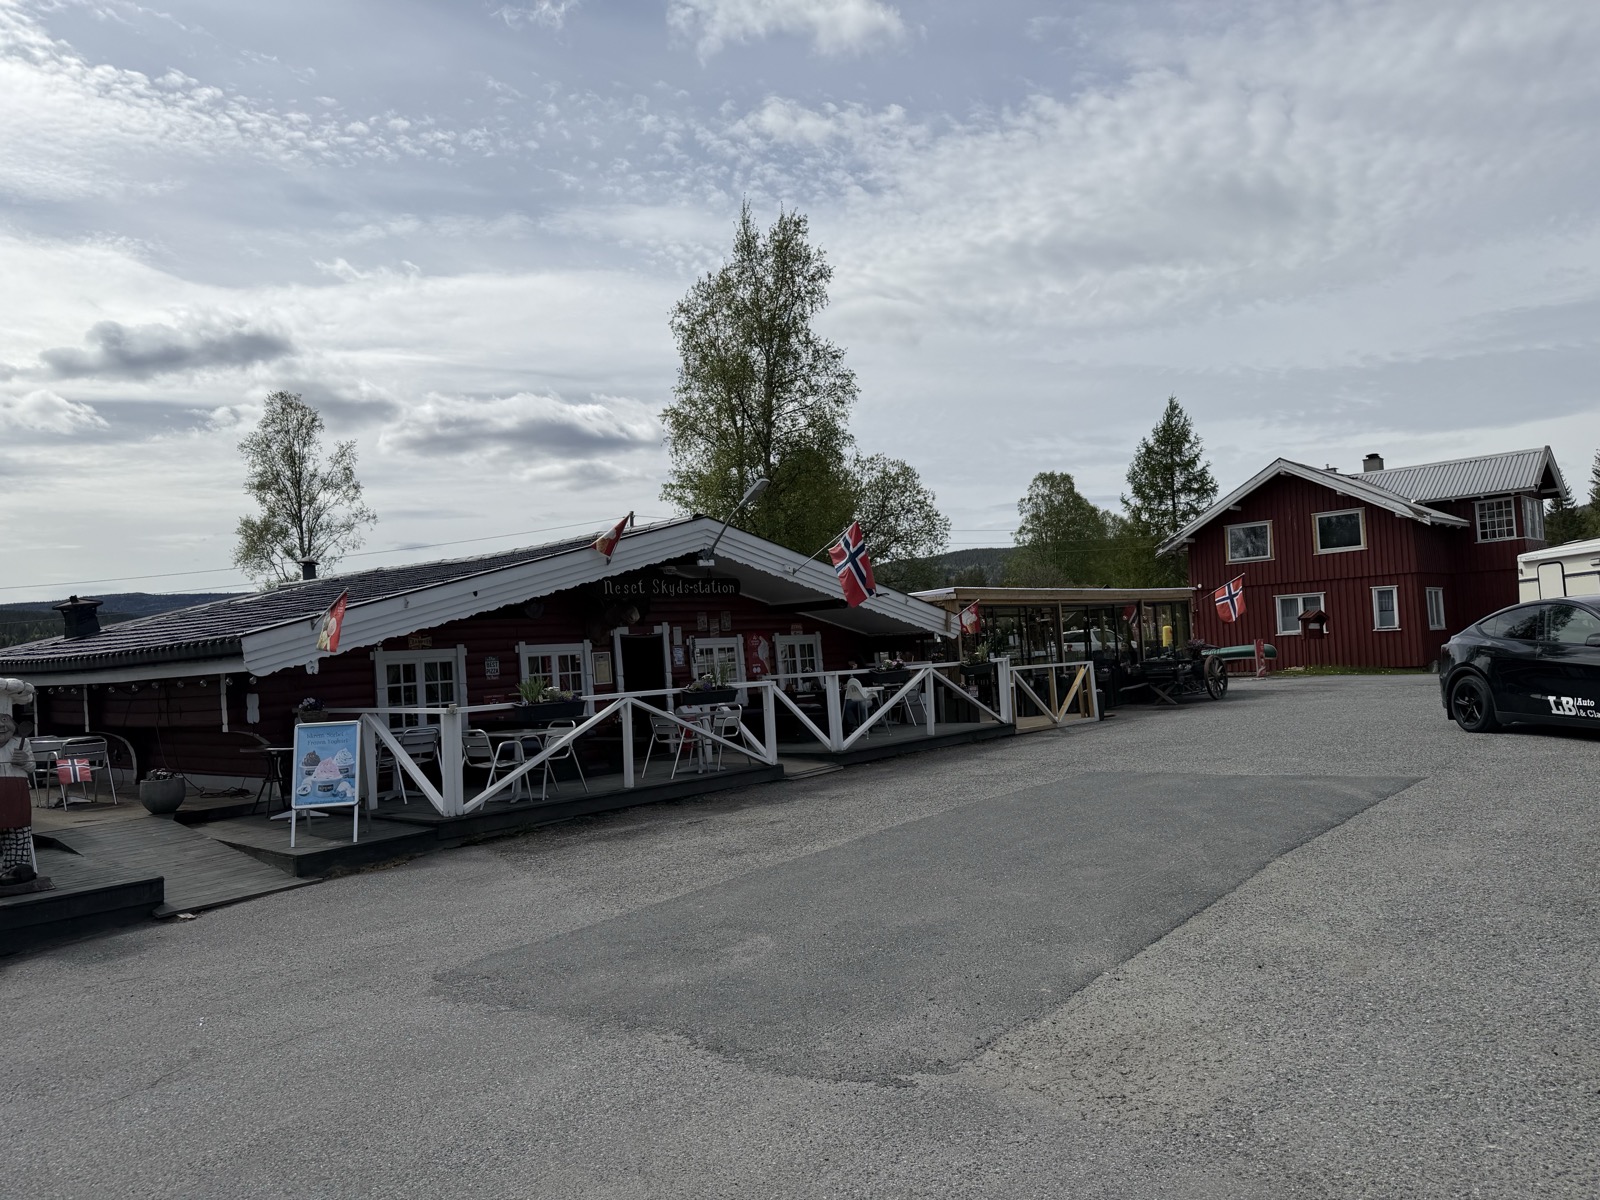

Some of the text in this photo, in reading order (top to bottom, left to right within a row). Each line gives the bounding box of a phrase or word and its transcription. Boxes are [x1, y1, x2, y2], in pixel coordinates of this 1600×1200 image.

[603, 578, 736, 597] Neset Skyds-station
[1547, 695, 1576, 716] LB
[1576, 697, 1595, 707] Auto
[1579, 709, 1587, 717] &
